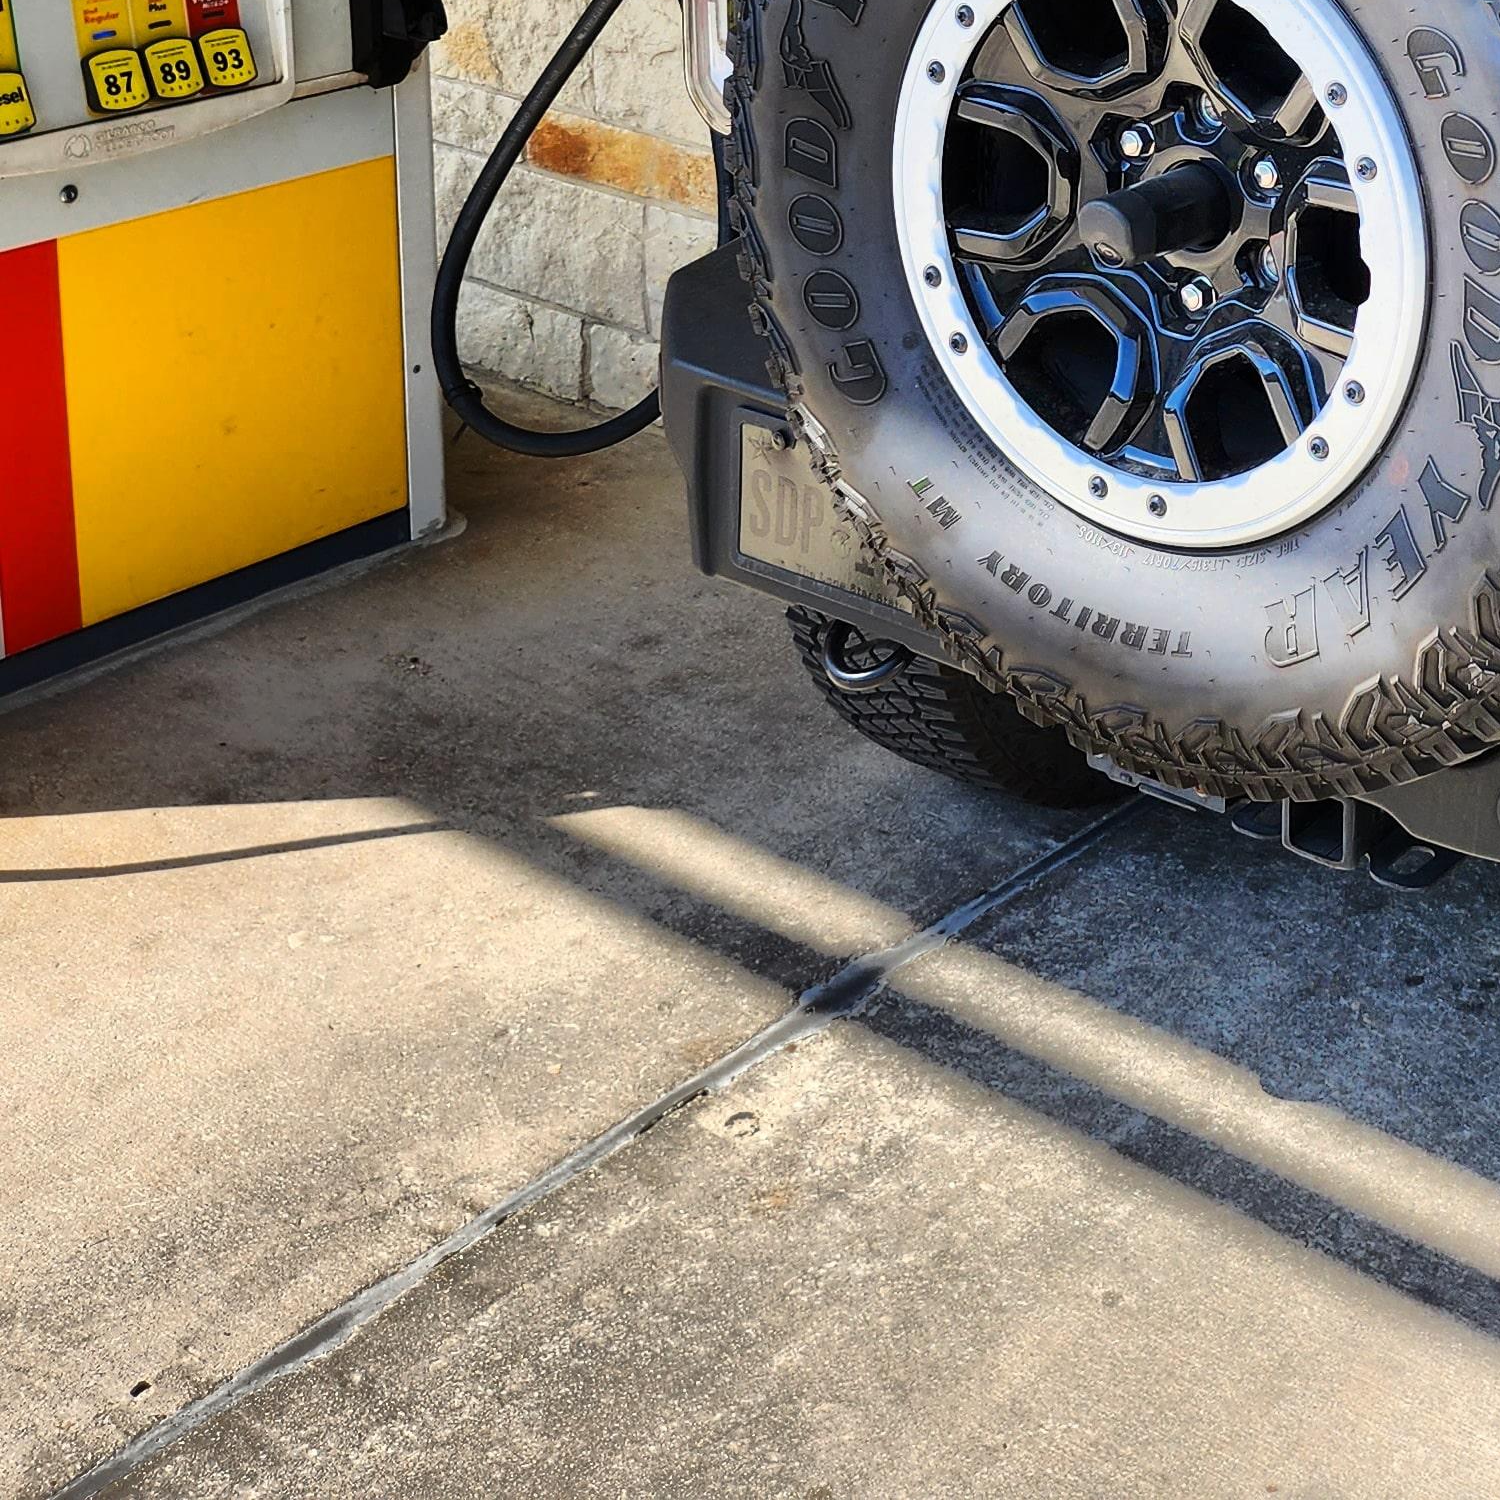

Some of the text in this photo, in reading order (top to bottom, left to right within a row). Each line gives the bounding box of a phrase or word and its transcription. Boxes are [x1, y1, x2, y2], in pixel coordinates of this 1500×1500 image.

[159, 59, 191, 84] 89
[212, 49, 244, 72] 93
[104, 71, 133, 96] 87
[975, 548, 1194, 659] TERRITORY
